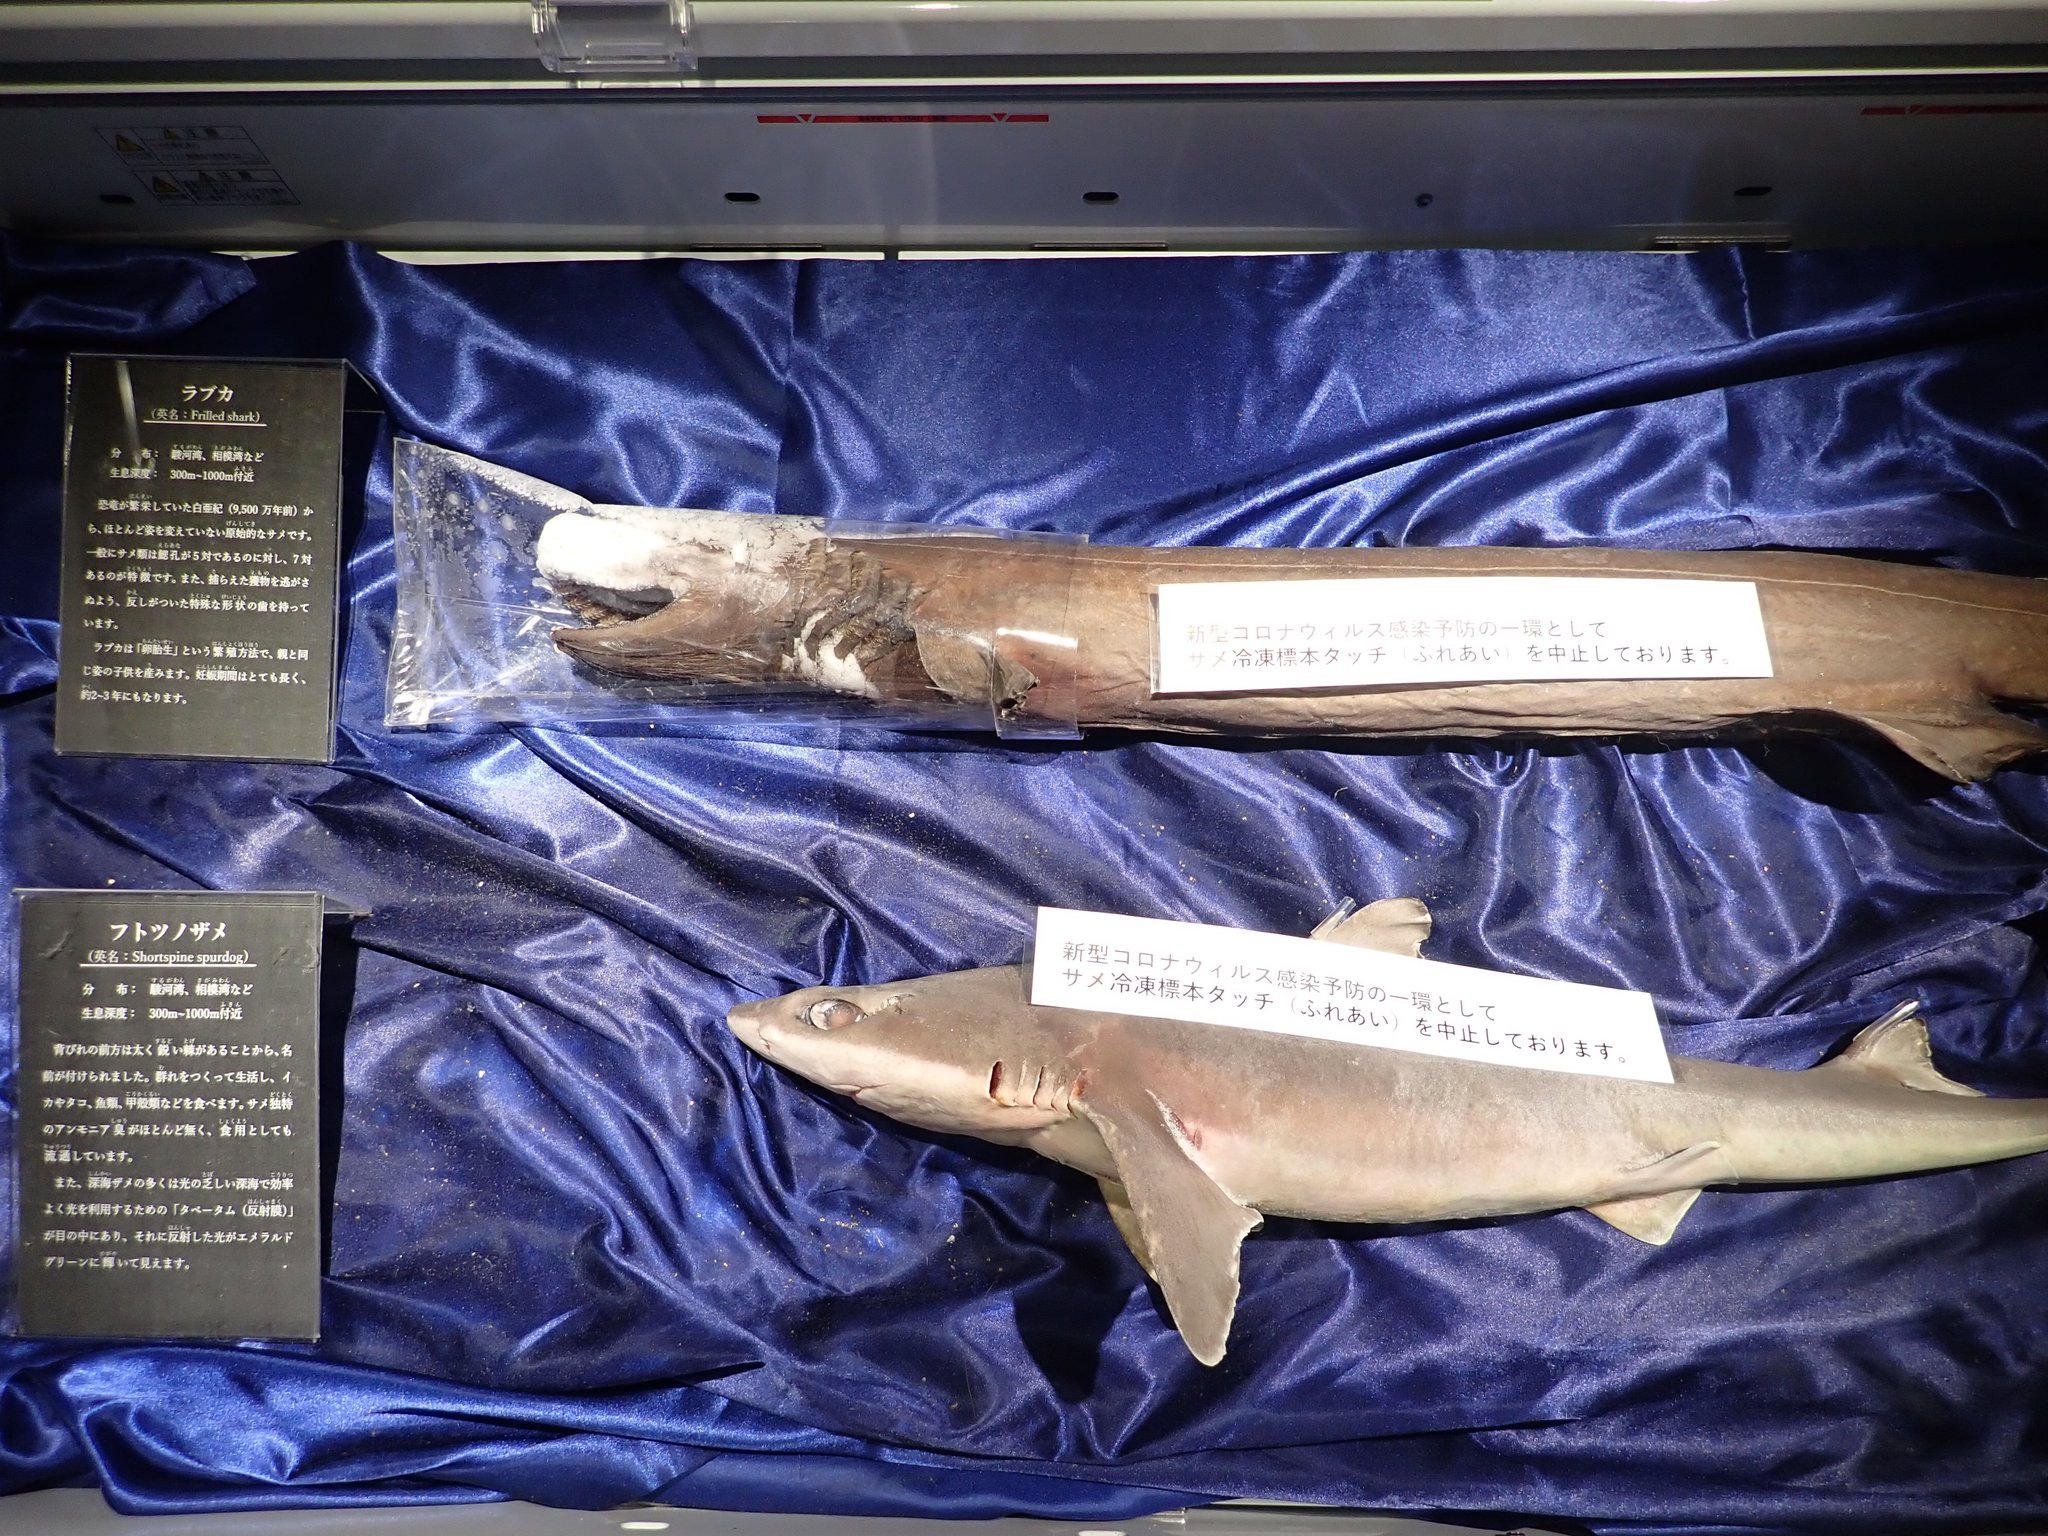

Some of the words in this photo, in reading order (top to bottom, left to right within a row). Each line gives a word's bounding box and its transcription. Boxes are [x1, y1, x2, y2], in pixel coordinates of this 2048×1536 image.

[182, 386, 234, 402] ラブカ
[88, 524, 312, 542] ら、ほとんど姿を変えていない原始的なサメです。
[84, 594, 309, 613] ぬよう、反しがついた特殊な形状の歯を持って
[84, 618, 119, 630] います。
[1187, 618, 1606, 644] 新型コロナウィルス感染予防の一環として
[83, 666, 306, 684] じ姿の子供を産みます。妊娠期間はとても長く、
[110, 923, 226, 943] フトツノザメ
[1062, 940, 1496, 1023] 新型コロナウィルス感染予防の一環として
[149, 984, 252, 996] 駿河湾、相模湾など
[81, 1008, 135, 1020] 生息深度：
[1062, 968, 1627, 1065] サメ冷凍標本タッチ（ふれあい）を中止しております。
[43, 1071, 290, 1084] 前が付けられました。群れをつくって生活し、イ
[43, 1098, 293, 1111] カやタコ、魚類、甲殻類などを食べます。サメ独特
[43, 1124, 292, 1137] のアンモニア臭がほとんど無く、食用としても
[43, 1150, 133, 1163] 流通しています。
[44, 1230, 293, 1244] が目の中にあり、それに反射した光がエメラルド
[44, 1257, 191, 1270] グリーンに輝いて見えます。
